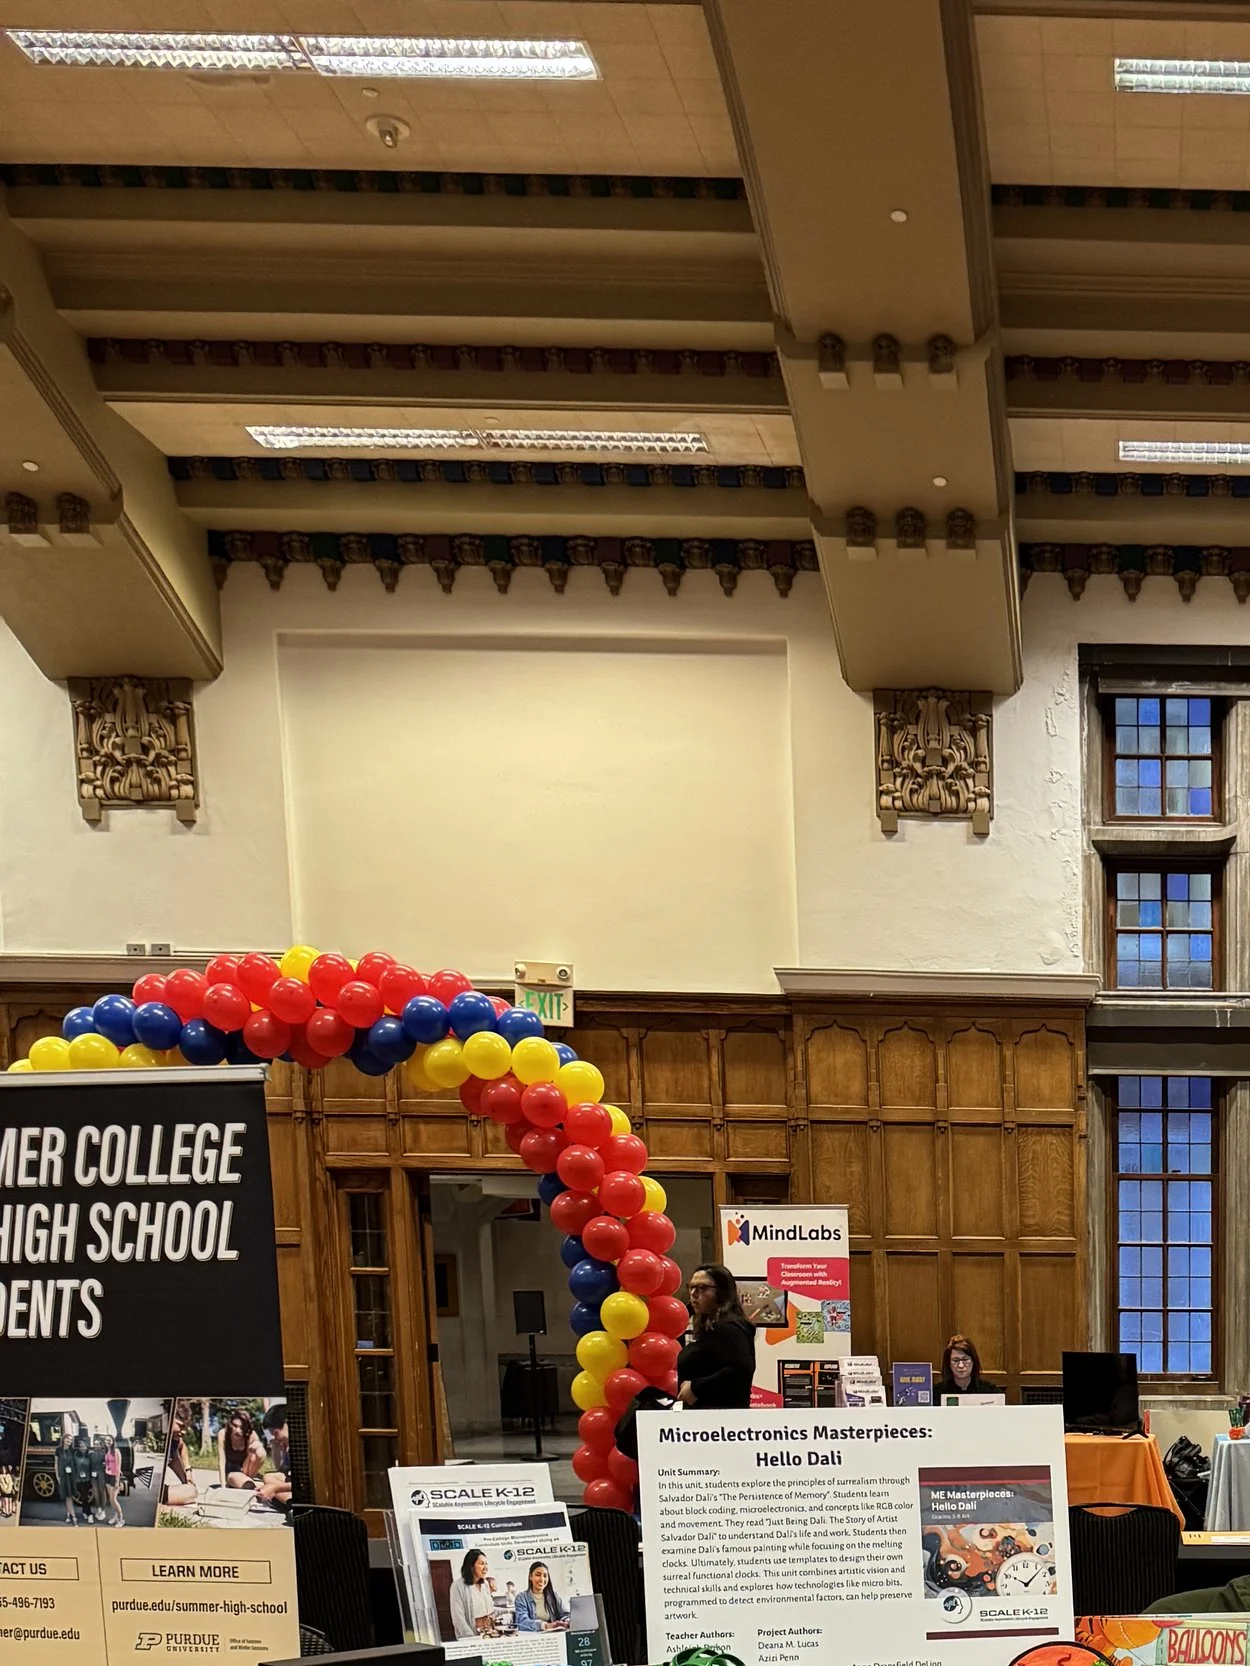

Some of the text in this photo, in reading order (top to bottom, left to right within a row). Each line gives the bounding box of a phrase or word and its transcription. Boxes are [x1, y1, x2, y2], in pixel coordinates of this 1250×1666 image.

[525, 992, 563, 1020] EXIT
[74, 1122, 247, 1186] COLLEGE
[86, 1200, 240, 1263] SCHOOL
[752, 1224, 842, 1241] MindLabs
[0, 1278, 104, 1339] ENTS
[659, 1424, 933, 1444] Microelectronics Masterpieces:
[756, 1451, 842, 1467] Hello Dali
[430, 1487, 535, 1500] SCALE K-12
[931, 1490, 1014, 1501] ME Masterpieces:
[932, 1502, 956, 1511] Hello
[29, 1563, 47, 1575] US
[152, 1565, 239, 1579] LEARN MORE
[112, 1599, 288, 1615] purdue.edu/summer-high-school
[980, 1607, 1049, 1618] SCALE K-12
[166, 1633, 220, 1646] PURDUE
[757, 1627, 823, 1638] Project Authors:
[578, 1637, 590, 1647] 28
[785, 1640, 796, 1649] M.
[797, 1639, 820, 1649] Lucas
[1168, 1628, 1246, 1664] BALLOONS
